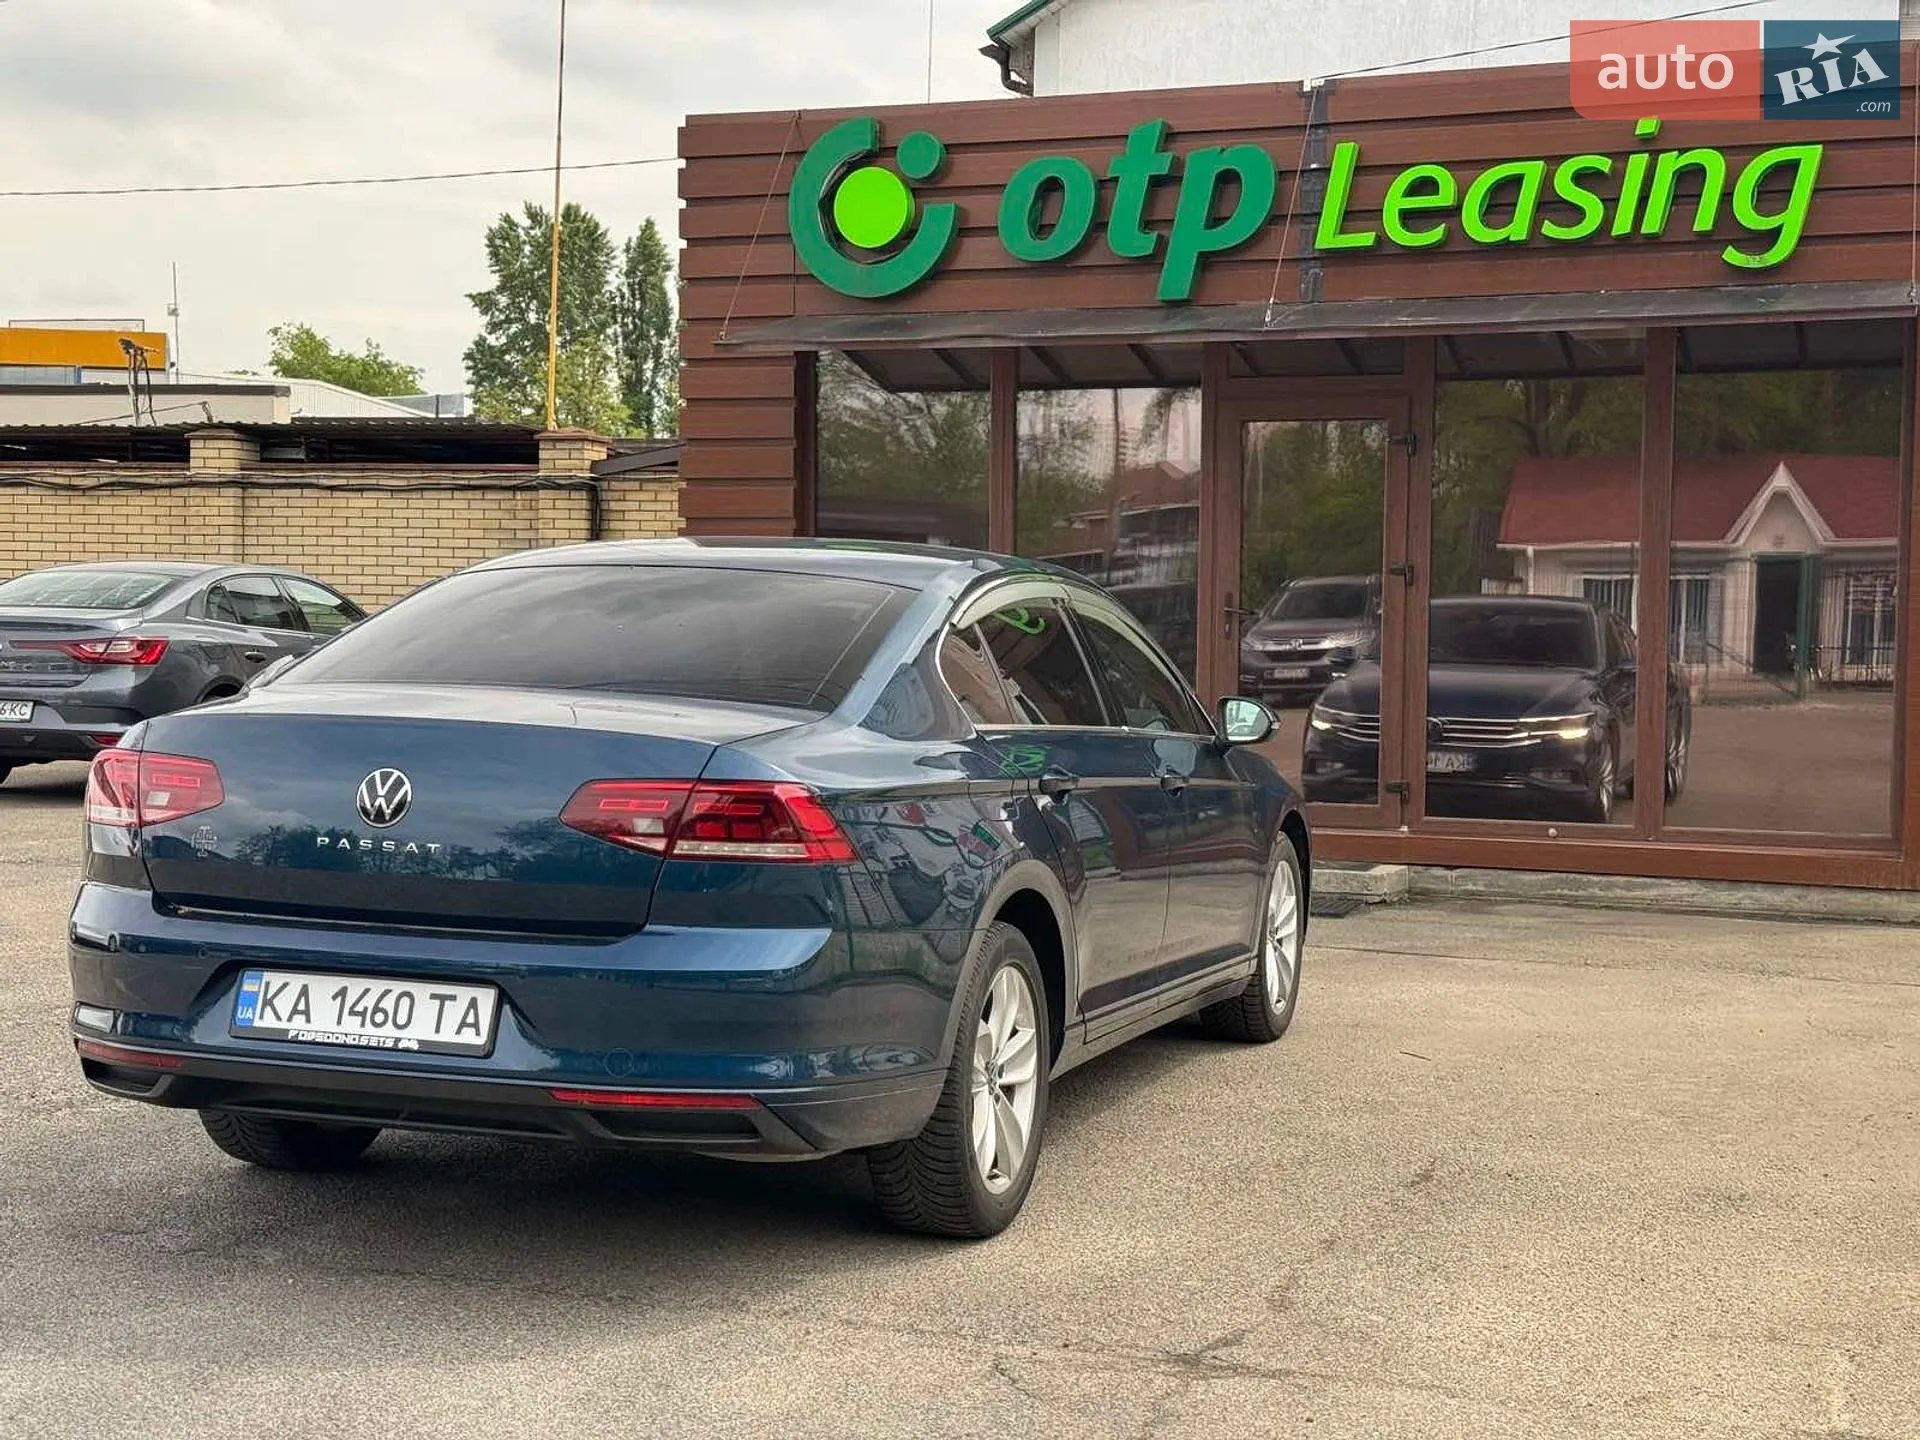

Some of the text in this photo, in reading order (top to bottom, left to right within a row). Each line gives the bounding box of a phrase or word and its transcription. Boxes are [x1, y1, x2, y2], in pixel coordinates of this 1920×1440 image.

[998, 116, 1824, 302] otp Leasing
[316, 836, 441, 854] PASSAT
[237, 1005, 254, 1020] UA
[258, 980, 482, 1036] KA 1460 TA
